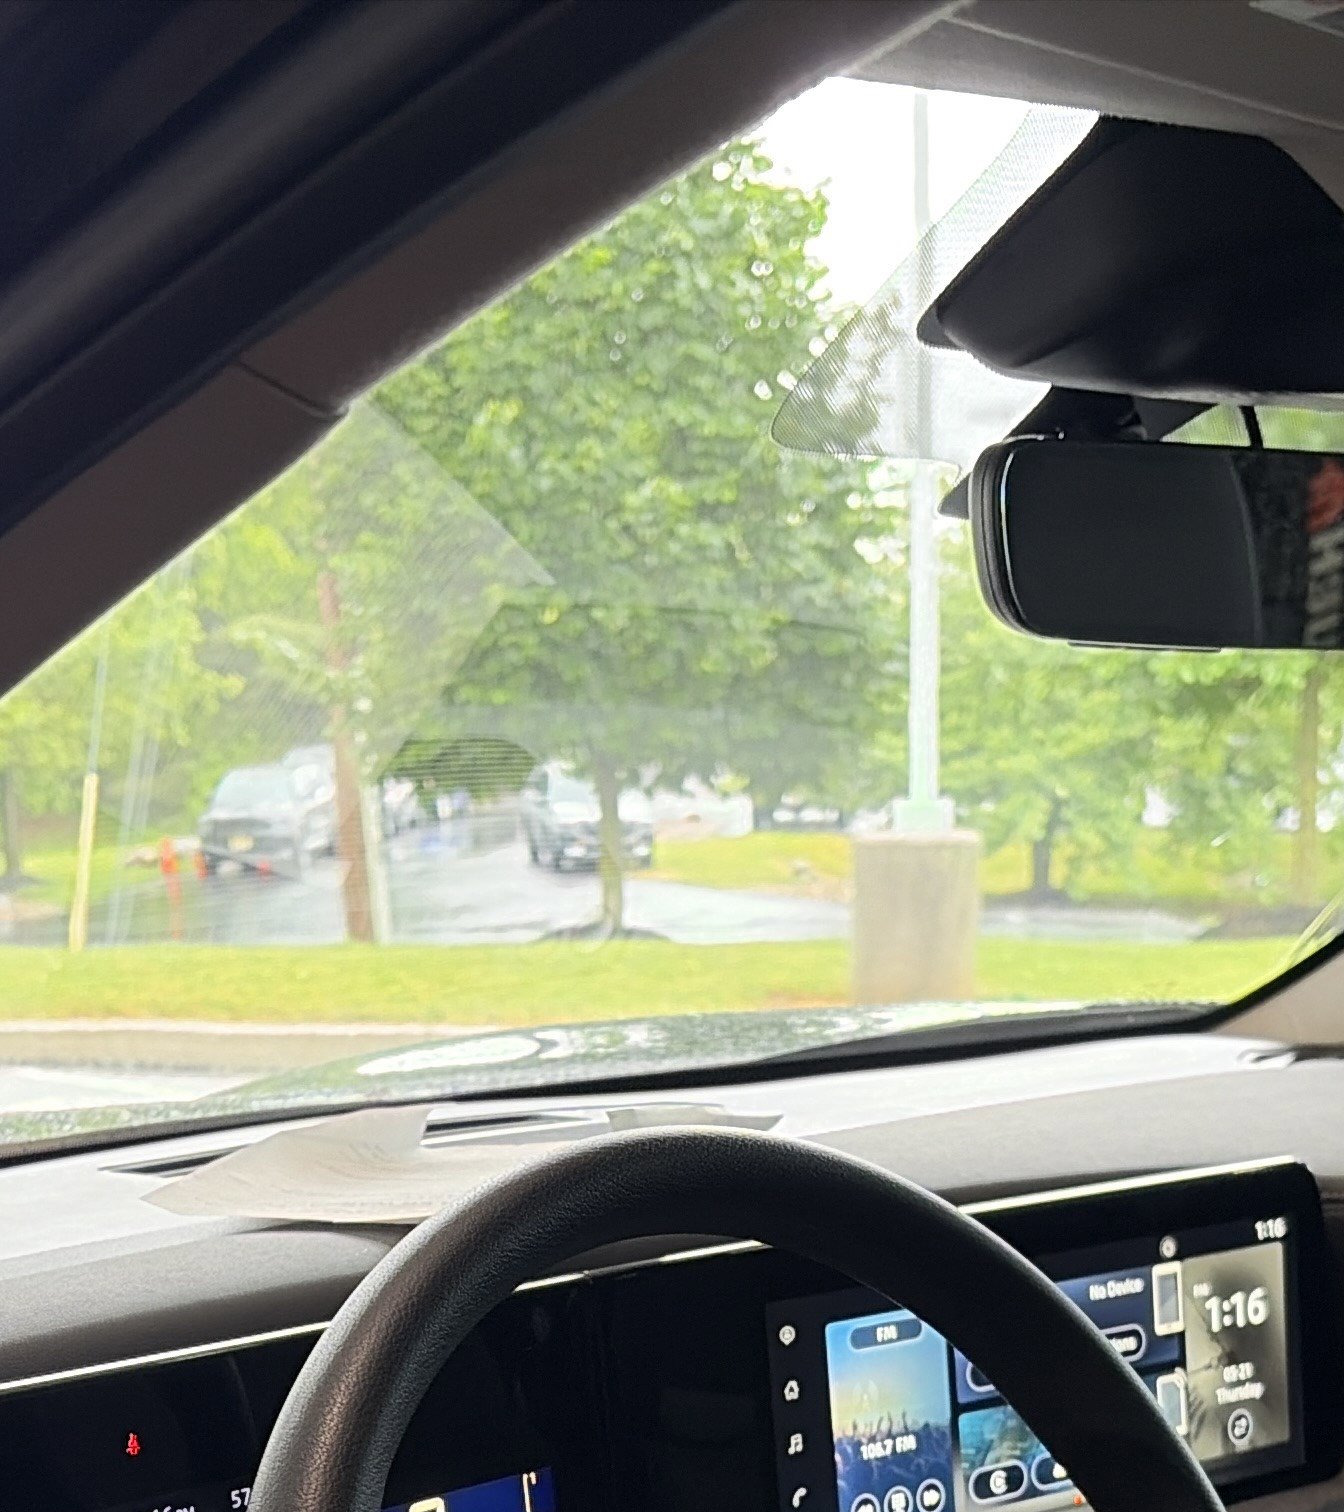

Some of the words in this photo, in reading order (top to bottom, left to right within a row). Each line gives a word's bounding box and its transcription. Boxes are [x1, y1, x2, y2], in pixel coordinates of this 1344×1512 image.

[1255, 1217, 1288, 1240] 1:16
[1089, 1284, 1107, 1300] No
[1107, 1277, 1145, 1298] Device
[1205, 1286, 1270, 1332] 1:16
[876, 1325, 897, 1343] FM
[895, 1434, 917, 1453] FM
